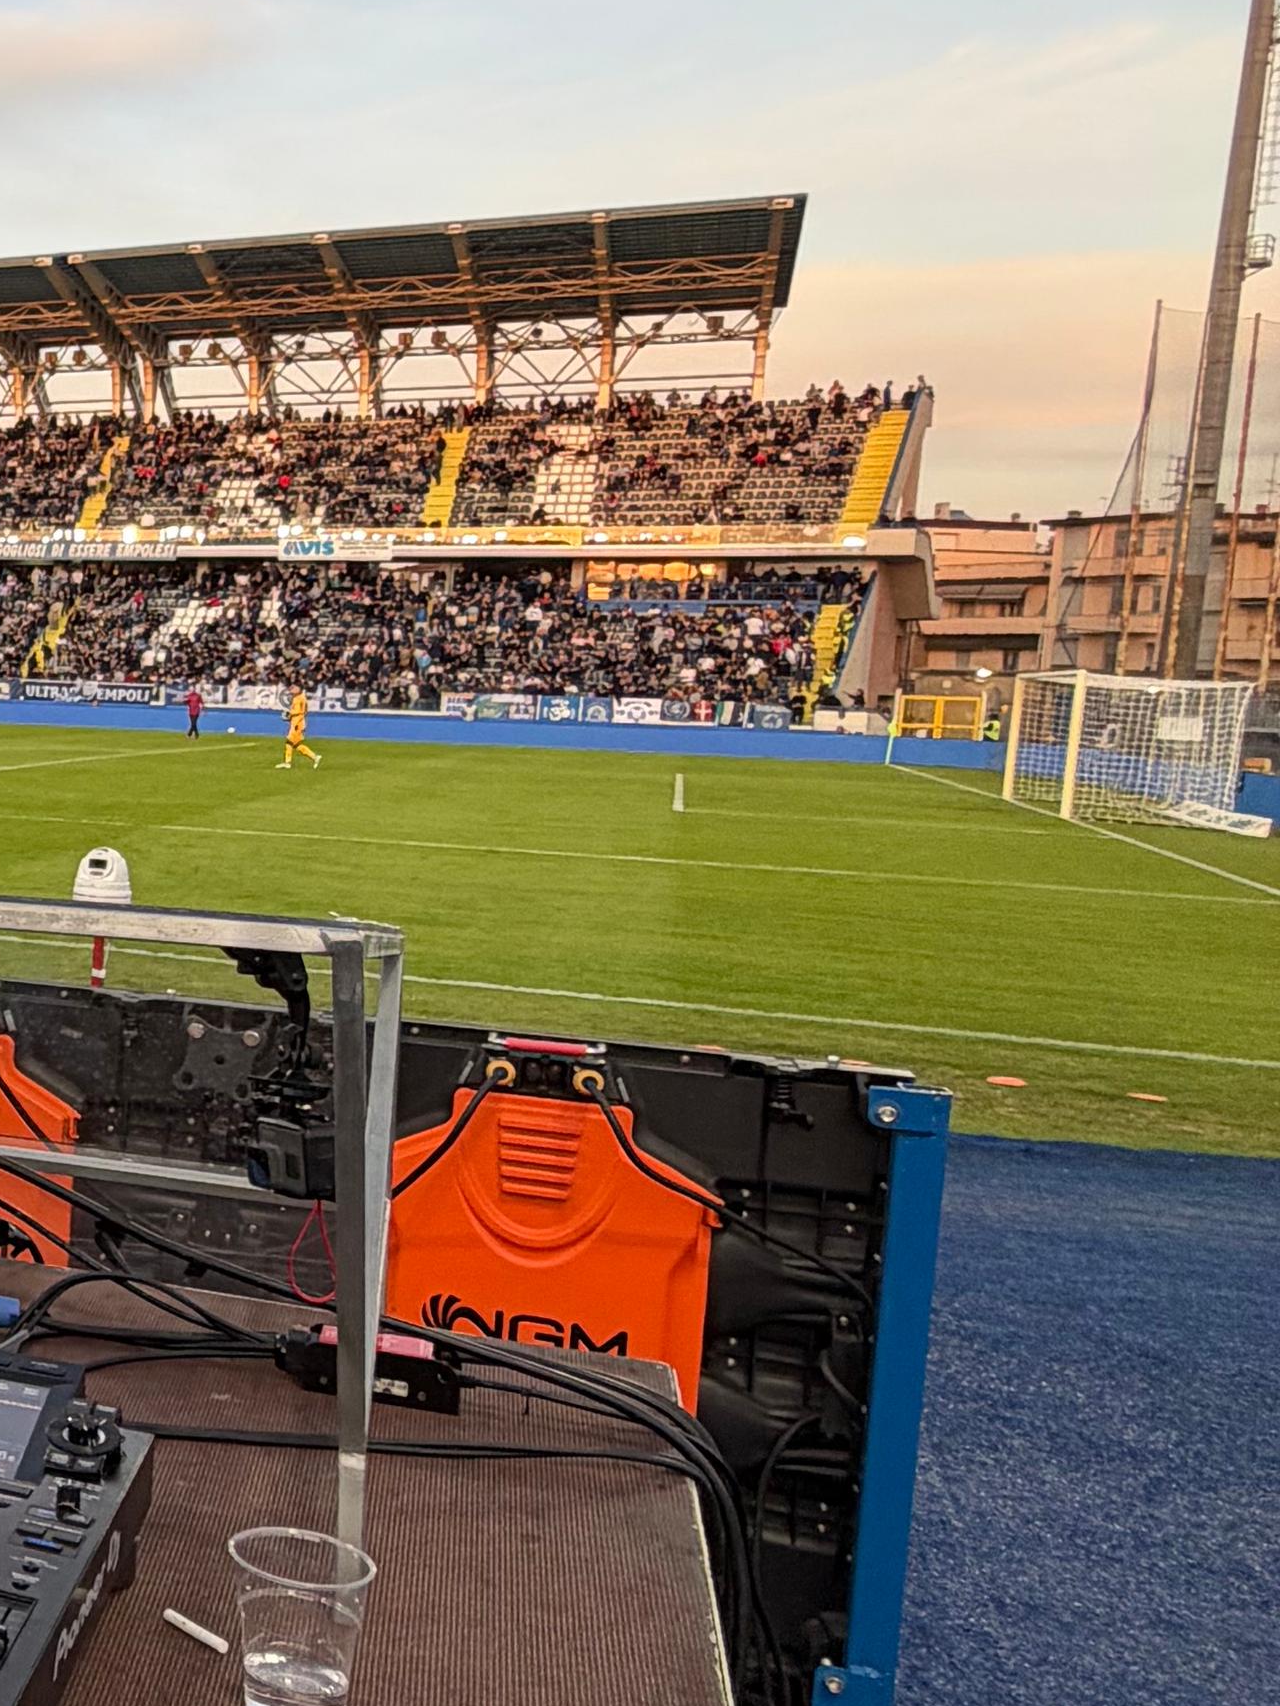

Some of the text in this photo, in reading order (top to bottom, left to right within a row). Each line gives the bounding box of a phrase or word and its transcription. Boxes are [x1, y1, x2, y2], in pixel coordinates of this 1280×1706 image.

[51, 543, 65, 557] DI
[69, 543, 112, 557] ESSERE
[116, 543, 176, 558] EMPOLESI
[283, 540, 335, 555] AVIS
[97, 687, 150, 703] EMPOLI
